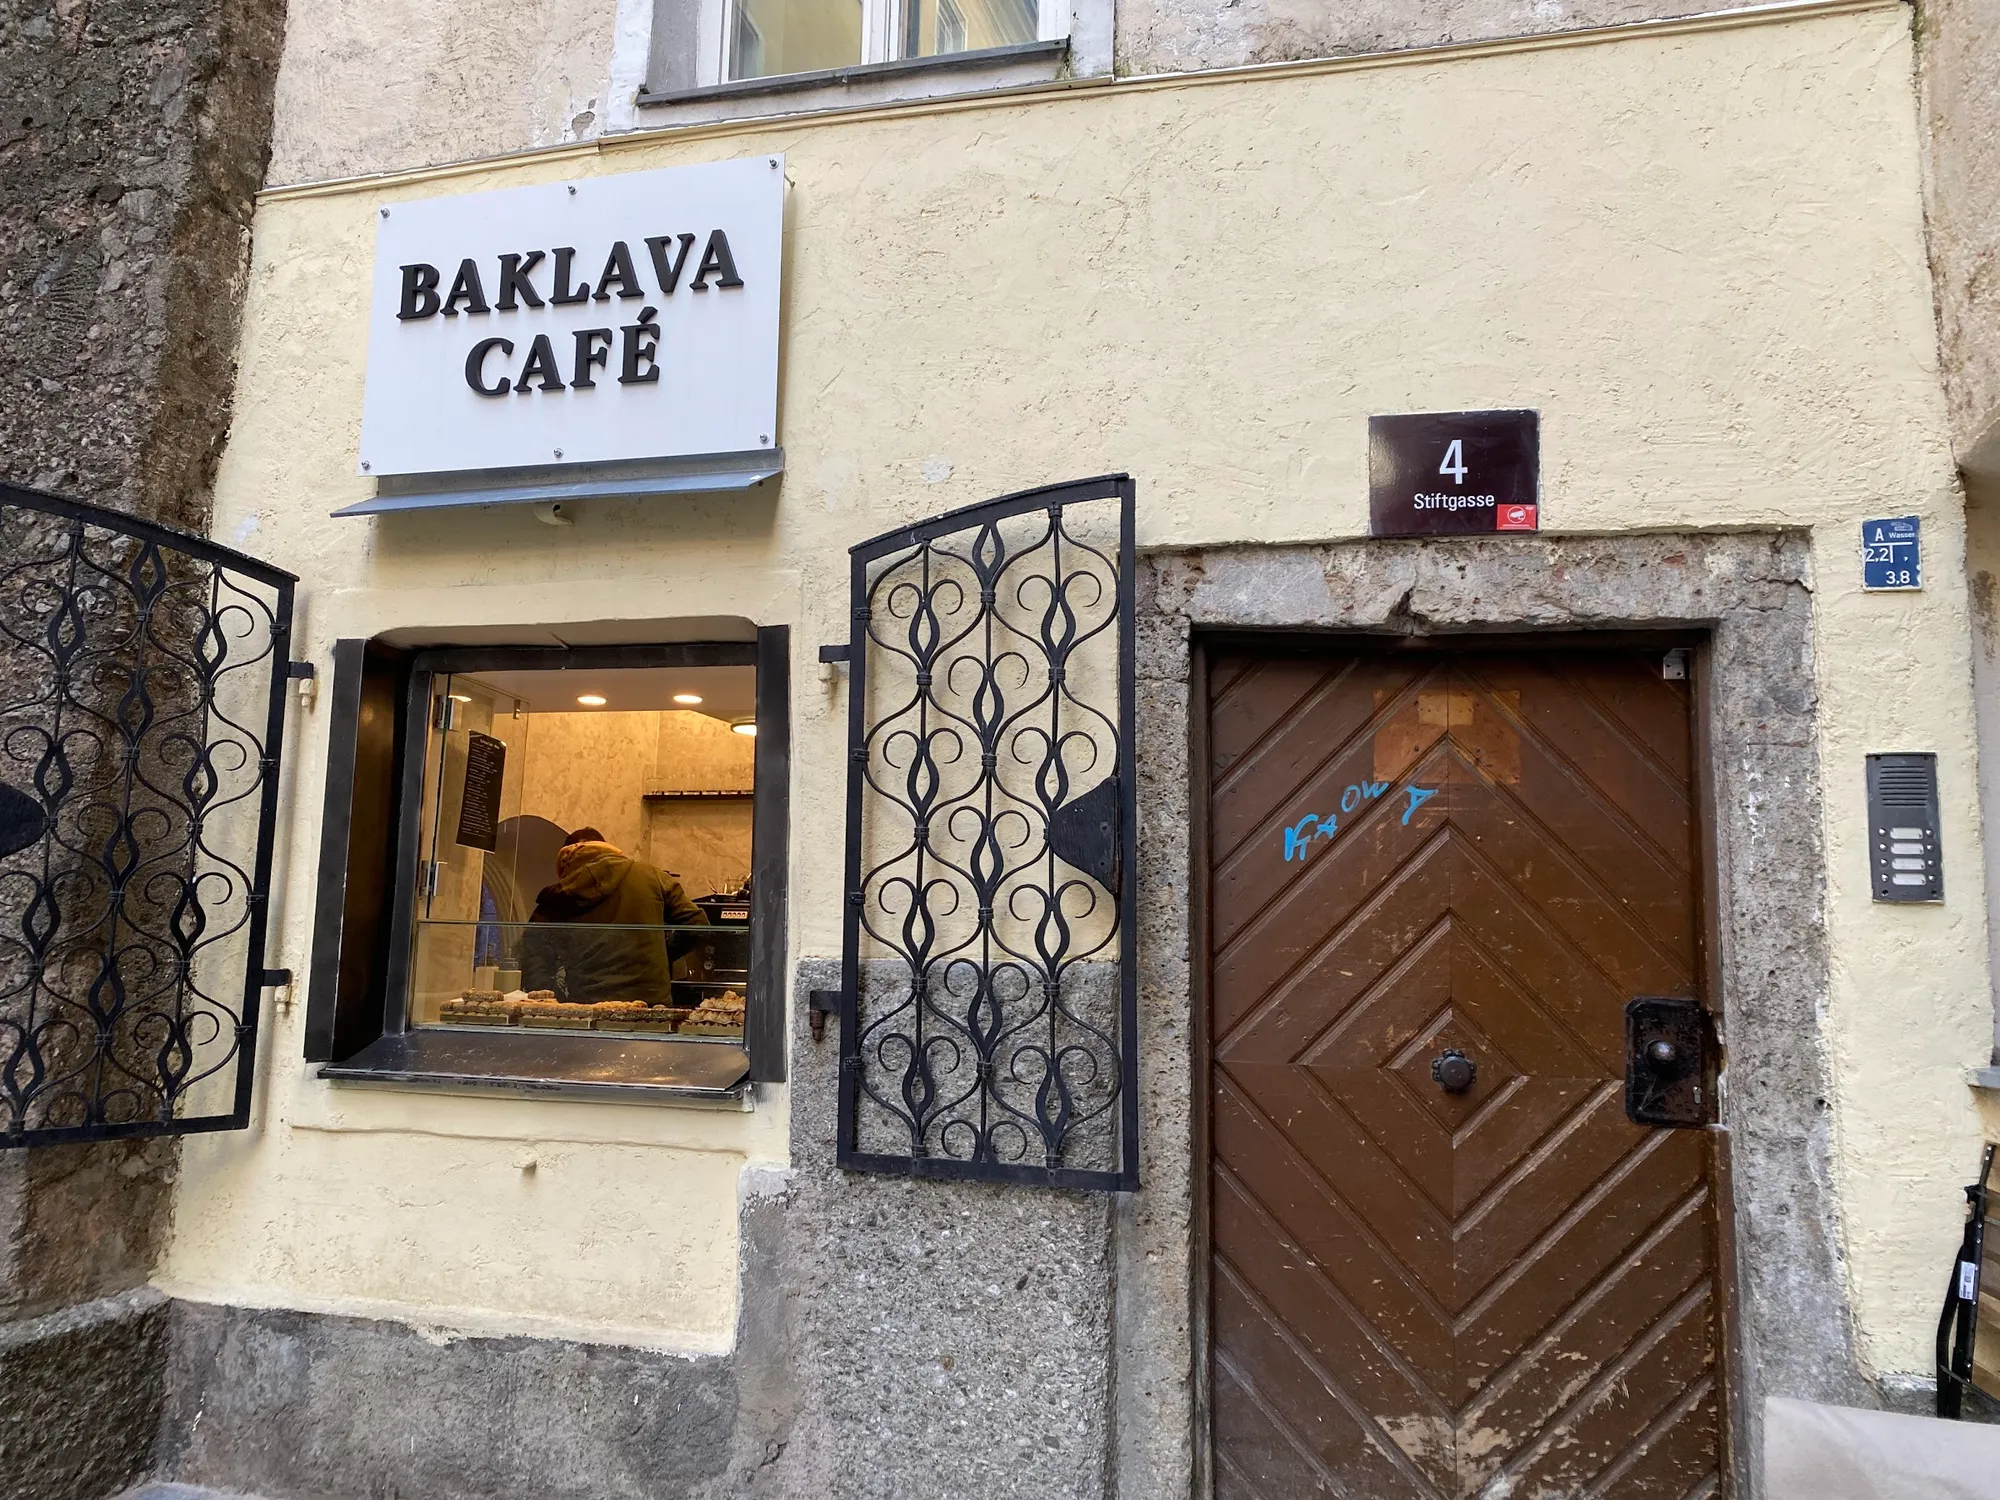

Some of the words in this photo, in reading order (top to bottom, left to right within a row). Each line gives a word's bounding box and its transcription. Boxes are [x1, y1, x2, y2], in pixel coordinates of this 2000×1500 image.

[396, 228, 744, 321] BAKLAVA
[465, 306, 661, 398] CAFÉ
[1439, 439, 1468, 485] 4
[1413, 492, 1495, 512] Stiftgasse
[1875, 527, 1885, 542] A
[1865, 548, 1890, 562] 2,2
[1886, 571, 1910, 585] 3,8
